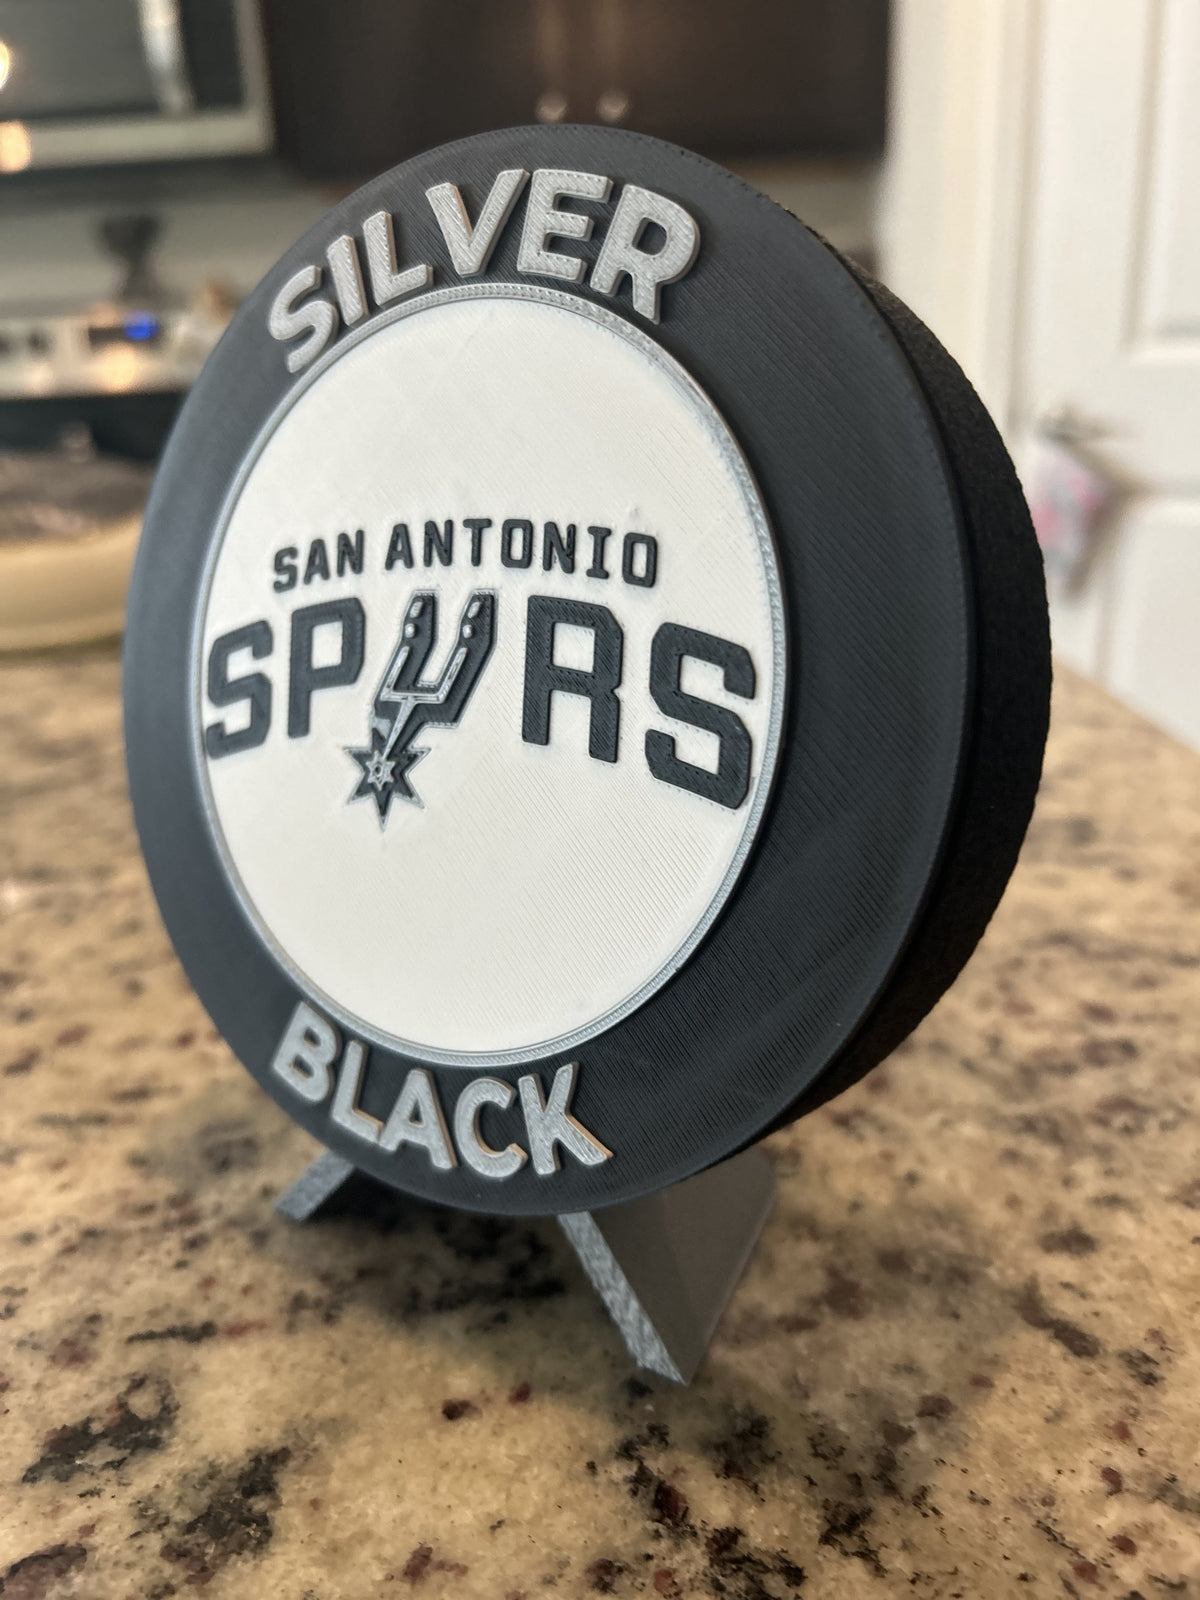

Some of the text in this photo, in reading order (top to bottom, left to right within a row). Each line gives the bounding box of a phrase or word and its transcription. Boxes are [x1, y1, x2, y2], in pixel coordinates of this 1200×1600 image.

[269, 168, 699, 373] SILVER
[273, 518, 658, 592] SAN ANTONIO
[205, 589, 756, 831] SPURS
[271, 1000, 614, 1178] BLACK
